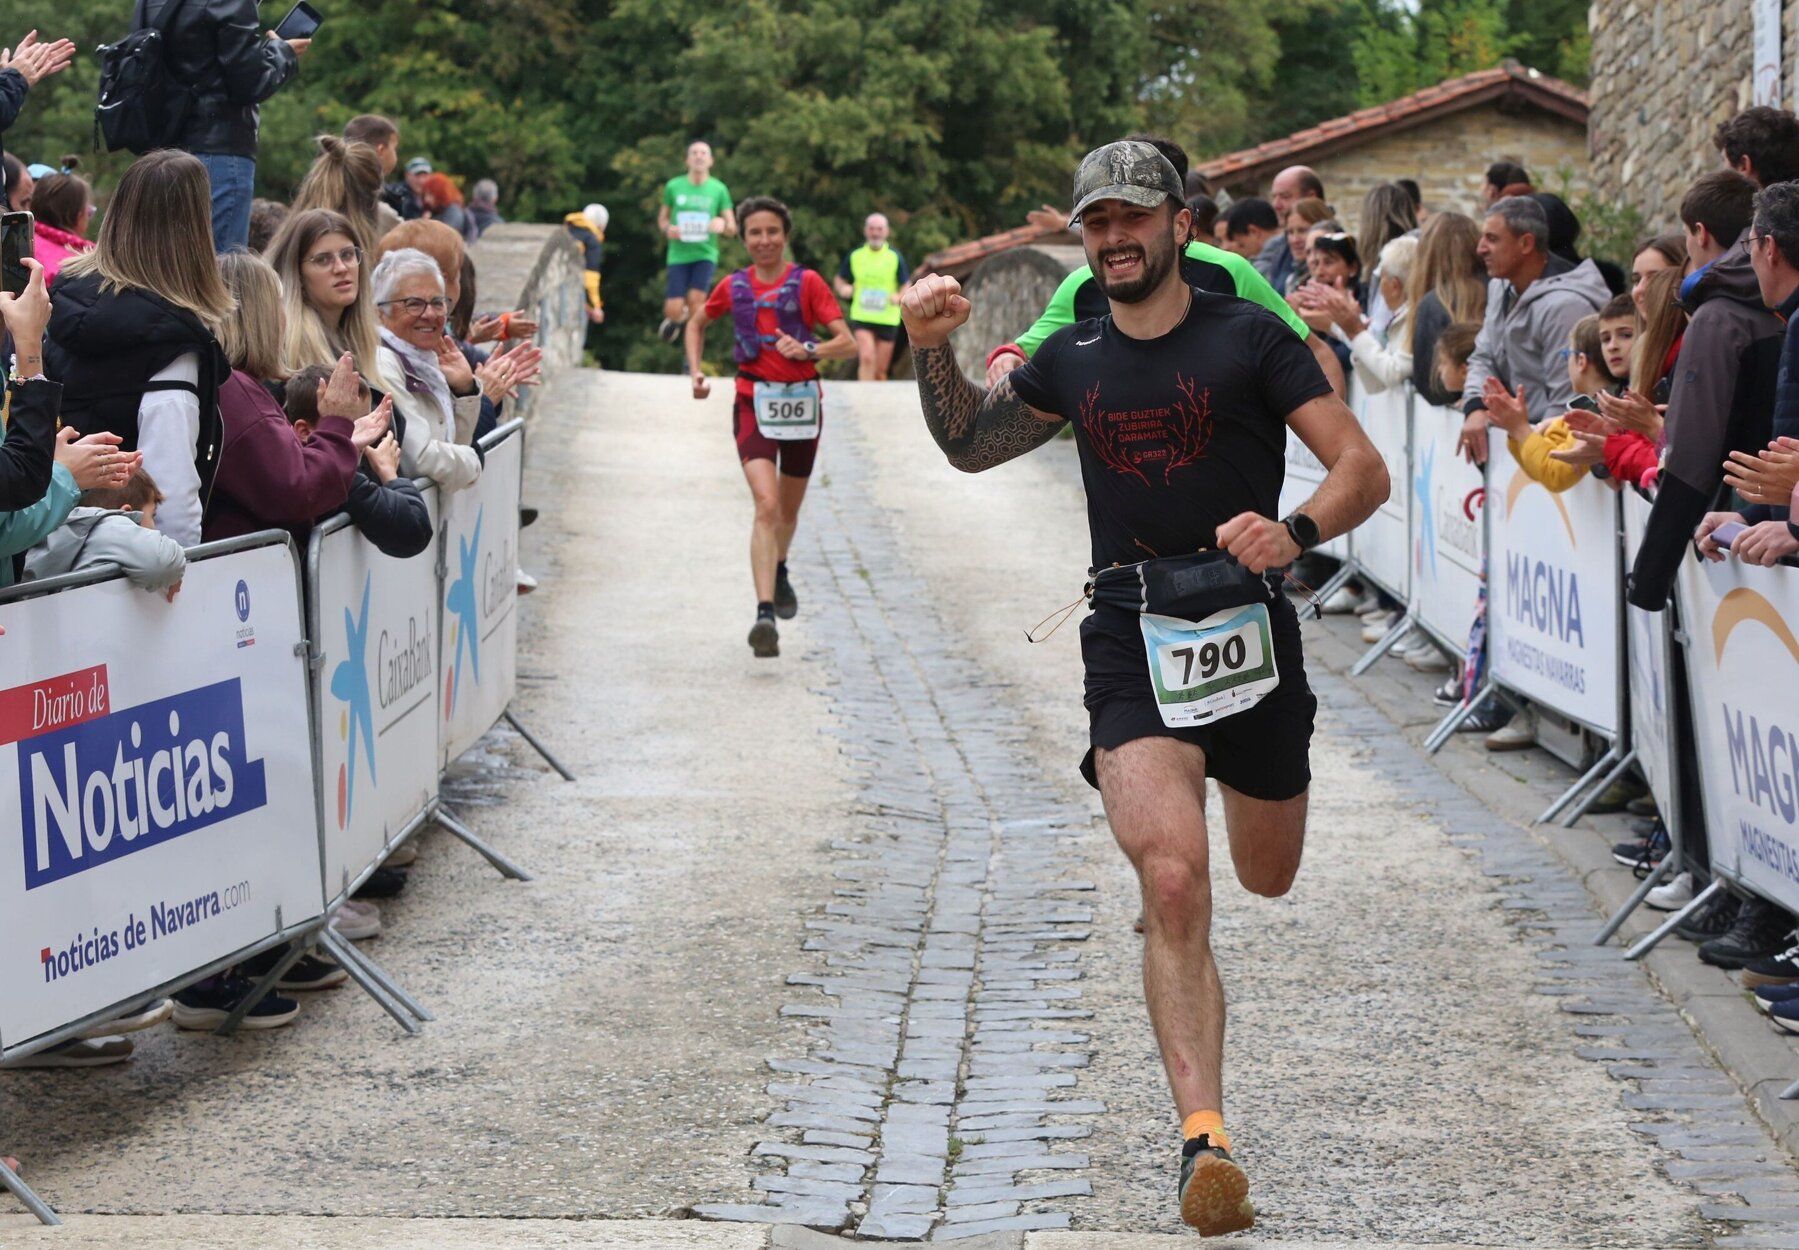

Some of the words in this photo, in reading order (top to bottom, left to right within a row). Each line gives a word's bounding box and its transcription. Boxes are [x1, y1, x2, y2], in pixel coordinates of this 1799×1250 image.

[768, 401, 805, 419] 506
[1107, 412, 1128, 421] BIDE
[1131, 408, 1171, 418] GUZTIEK
[1119, 430, 1168, 442] DARAMATE
[1506, 548, 1584, 648] MAGNA
[377, 608, 432, 710] CaixaBank
[1171, 634, 1246, 685] 790
[32, 682, 83, 730] Diario
[88, 672, 105, 714] de
[31, 710, 234, 871] Noticias
[43, 926, 119, 983] noticias
[124, 913, 146, 952] de
[151, 880, 251, 939] Navarra.com
